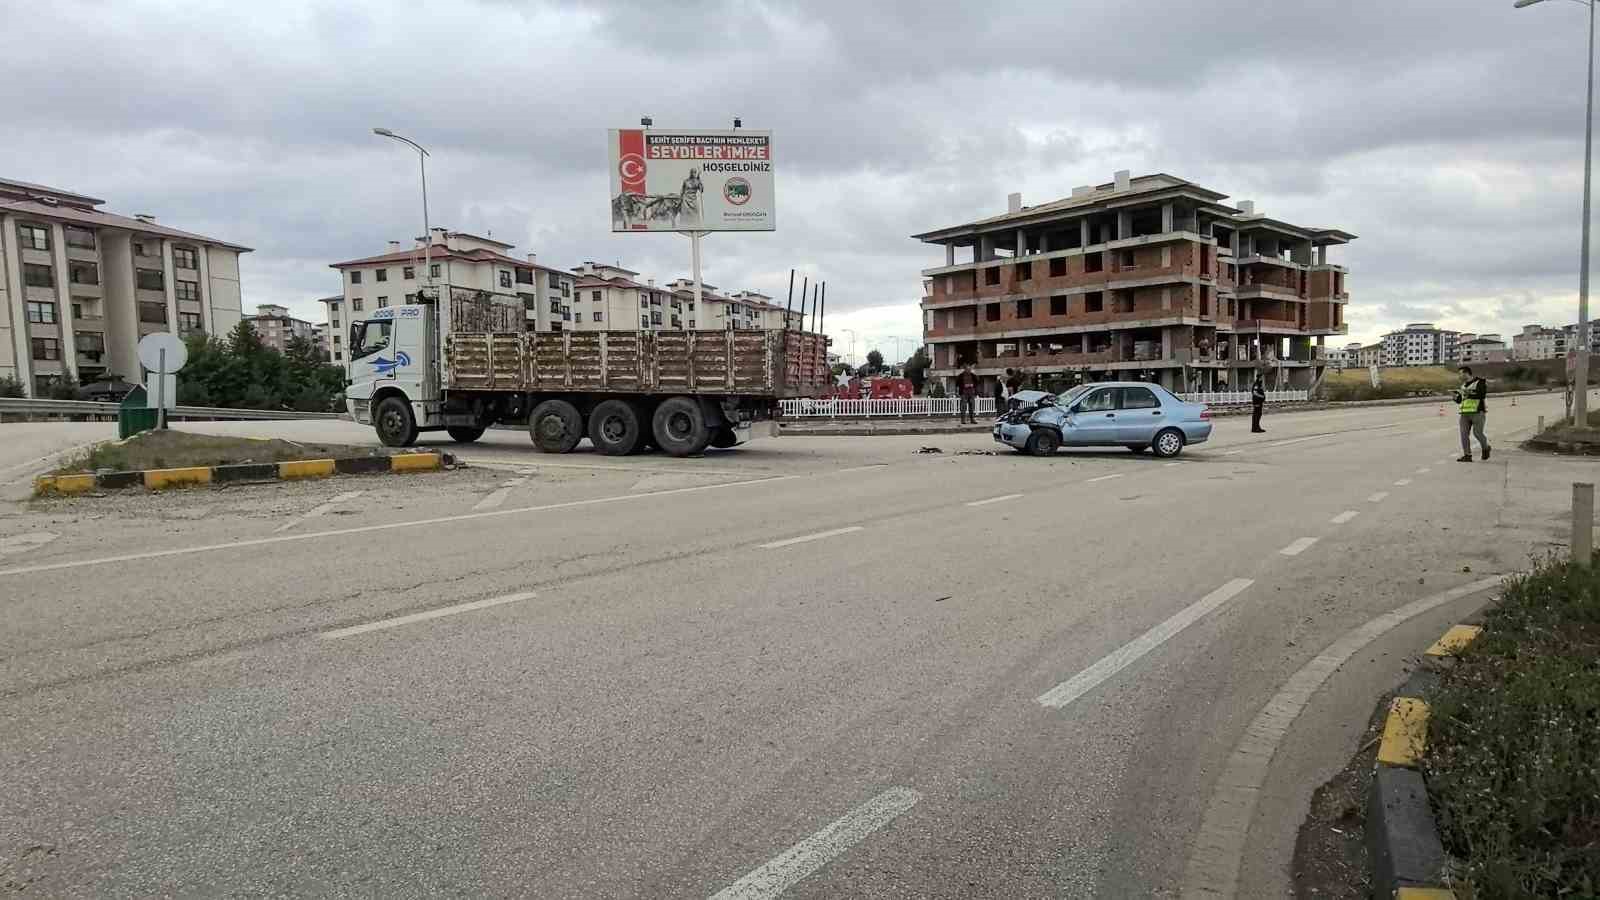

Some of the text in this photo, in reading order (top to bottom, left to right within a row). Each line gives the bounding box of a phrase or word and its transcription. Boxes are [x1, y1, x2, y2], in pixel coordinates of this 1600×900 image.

[727, 136, 766, 145] MEMLEKETİ
[651, 145, 766, 159] SEYDİLER'İMİZE
[703, 161, 770, 173] HOŞGELDİNİZ
